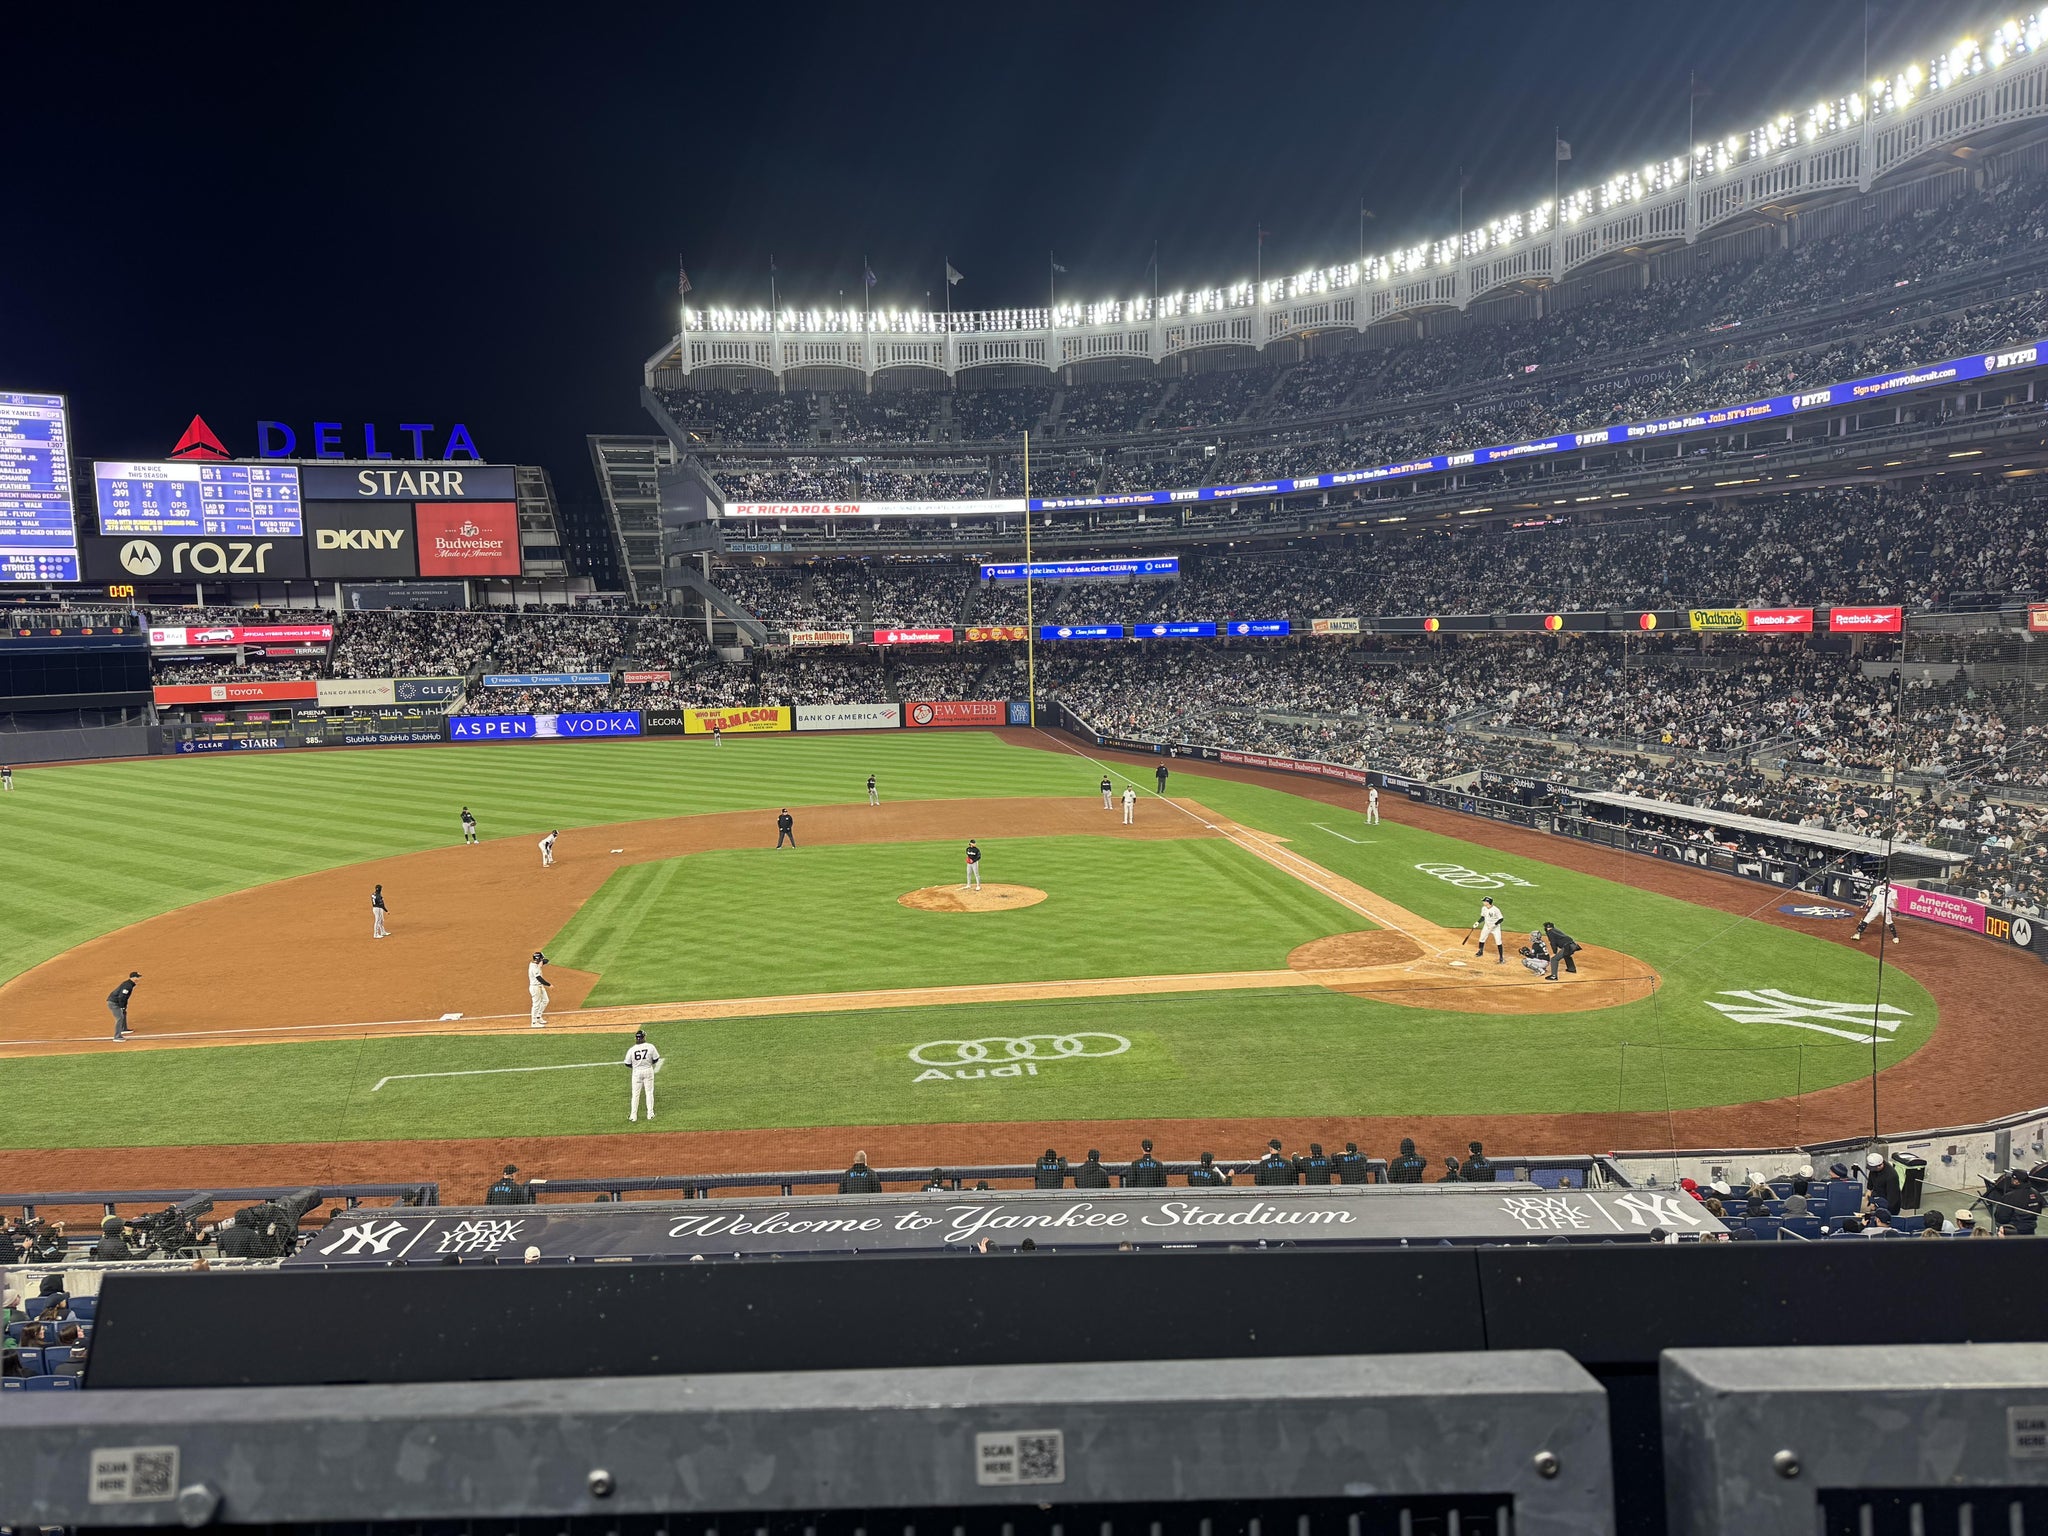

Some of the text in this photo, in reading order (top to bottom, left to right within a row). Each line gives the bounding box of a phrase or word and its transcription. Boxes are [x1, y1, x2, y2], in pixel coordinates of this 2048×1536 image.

[1998, 349, 2036, 368] NYPD
[1854, 386, 1870, 396] Sign
[1870, 385, 1880, 394] up
[1889, 368, 1956, 388] NYPDRecruit.com
[1802, 392, 1830, 406] NYPD
[1628, 428, 1645, 436] Step
[1646, 425, 1658, 434] Up
[1668, 421, 1682, 429] the
[1708, 414, 1726, 424] Join
[257, 421, 481, 460] DELTA
[358, 470, 464, 496] STARR
[737, 504, 860, 514] PC RICHARD & SON
[316, 529, 404, 550] DKNY
[435, 538, 504, 549] Budweiser
[172, 542, 272, 573] razr
[434, 548, 502, 558] Made of America
[110, 586, 134, 598] 0:09
[1699, 609, 1744, 627] Nathan's
[1754, 616, 1785, 625] Reebok
[1836, 614, 1872, 624] Reebok
[1330, 622, 1357, 630] AMAZING
[814, 632, 850, 642] Authority
[900, 632, 940, 641] Budweiser
[960, 704, 997, 715] WEBB
[455, 718, 636, 736] ASPEN VODKA
[648, 718, 683, 726] LEGORA
[240, 738, 278, 748] STARR
[346, 733, 442, 744] StubHub StubHub StubHub
[1514, 778, 1536, 789] StubHub
[1917, 894, 1967, 913] America's
[1910, 902, 1974, 924] Best Network
[634, 1049, 648, 1060] 67
[912, 1062, 1038, 1082] Audi
[1502, 1197, 1567, 1209] NEW
[1498, 1207, 1592, 1219] YORK
[452, 1219, 526, 1232] NEW
[669, 1202, 1357, 1242] Welcome to Yankee Stadium
[1521, 1218, 1590, 1230] LIFE
[440, 1228, 525, 1242] YORK
[435, 1240, 502, 1254] LIFE
